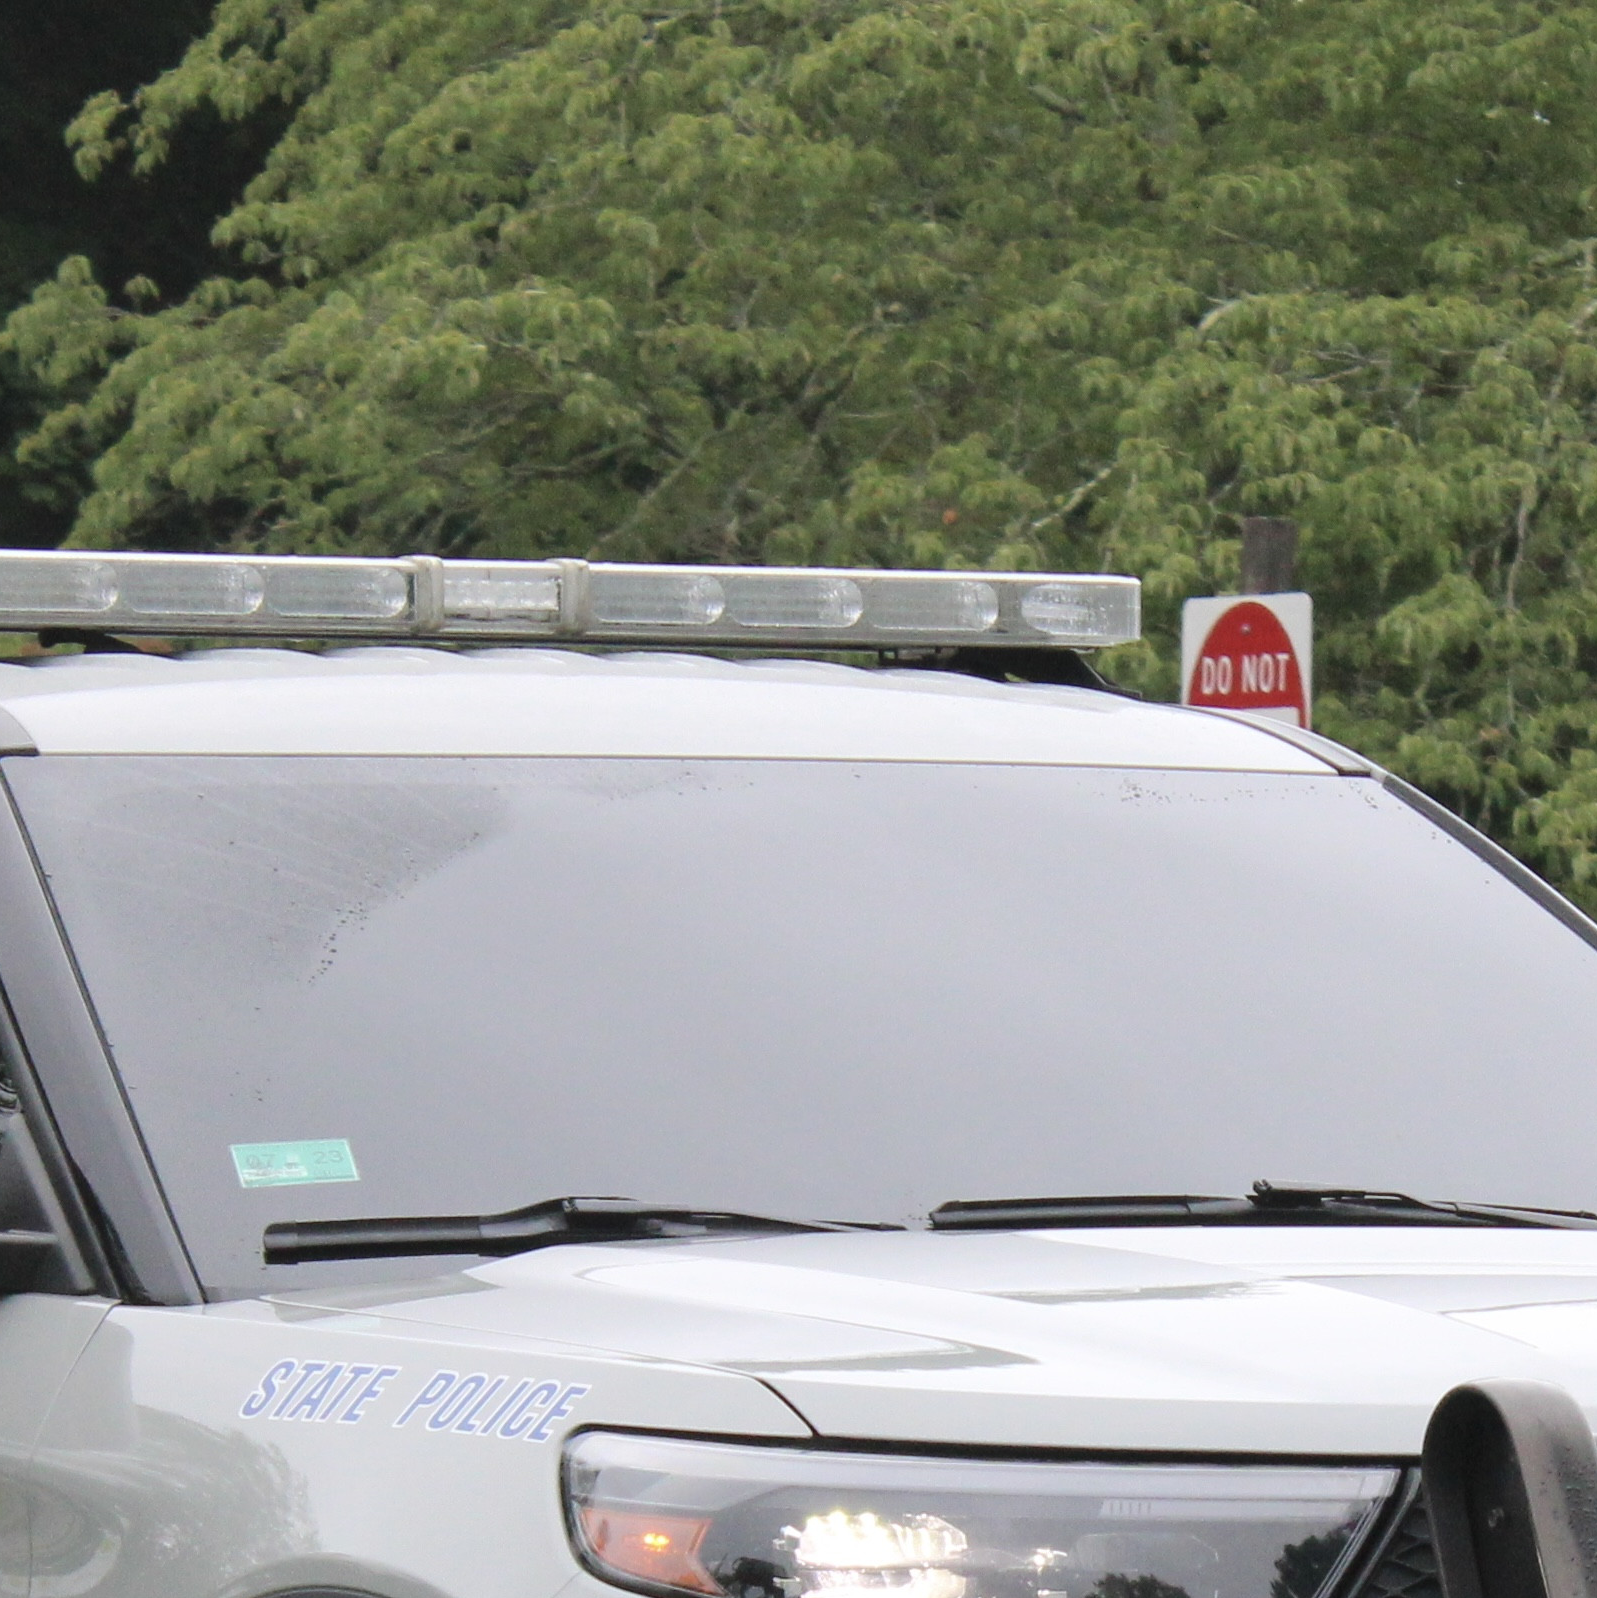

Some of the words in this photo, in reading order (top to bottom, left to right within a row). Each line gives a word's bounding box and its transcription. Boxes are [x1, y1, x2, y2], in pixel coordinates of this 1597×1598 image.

[1202, 656, 1232, 695] DO
[1241, 652, 1290, 694] NOT
[239, 1357, 402, 1424] STATE
[392, 1369, 592, 1443] POLICE
